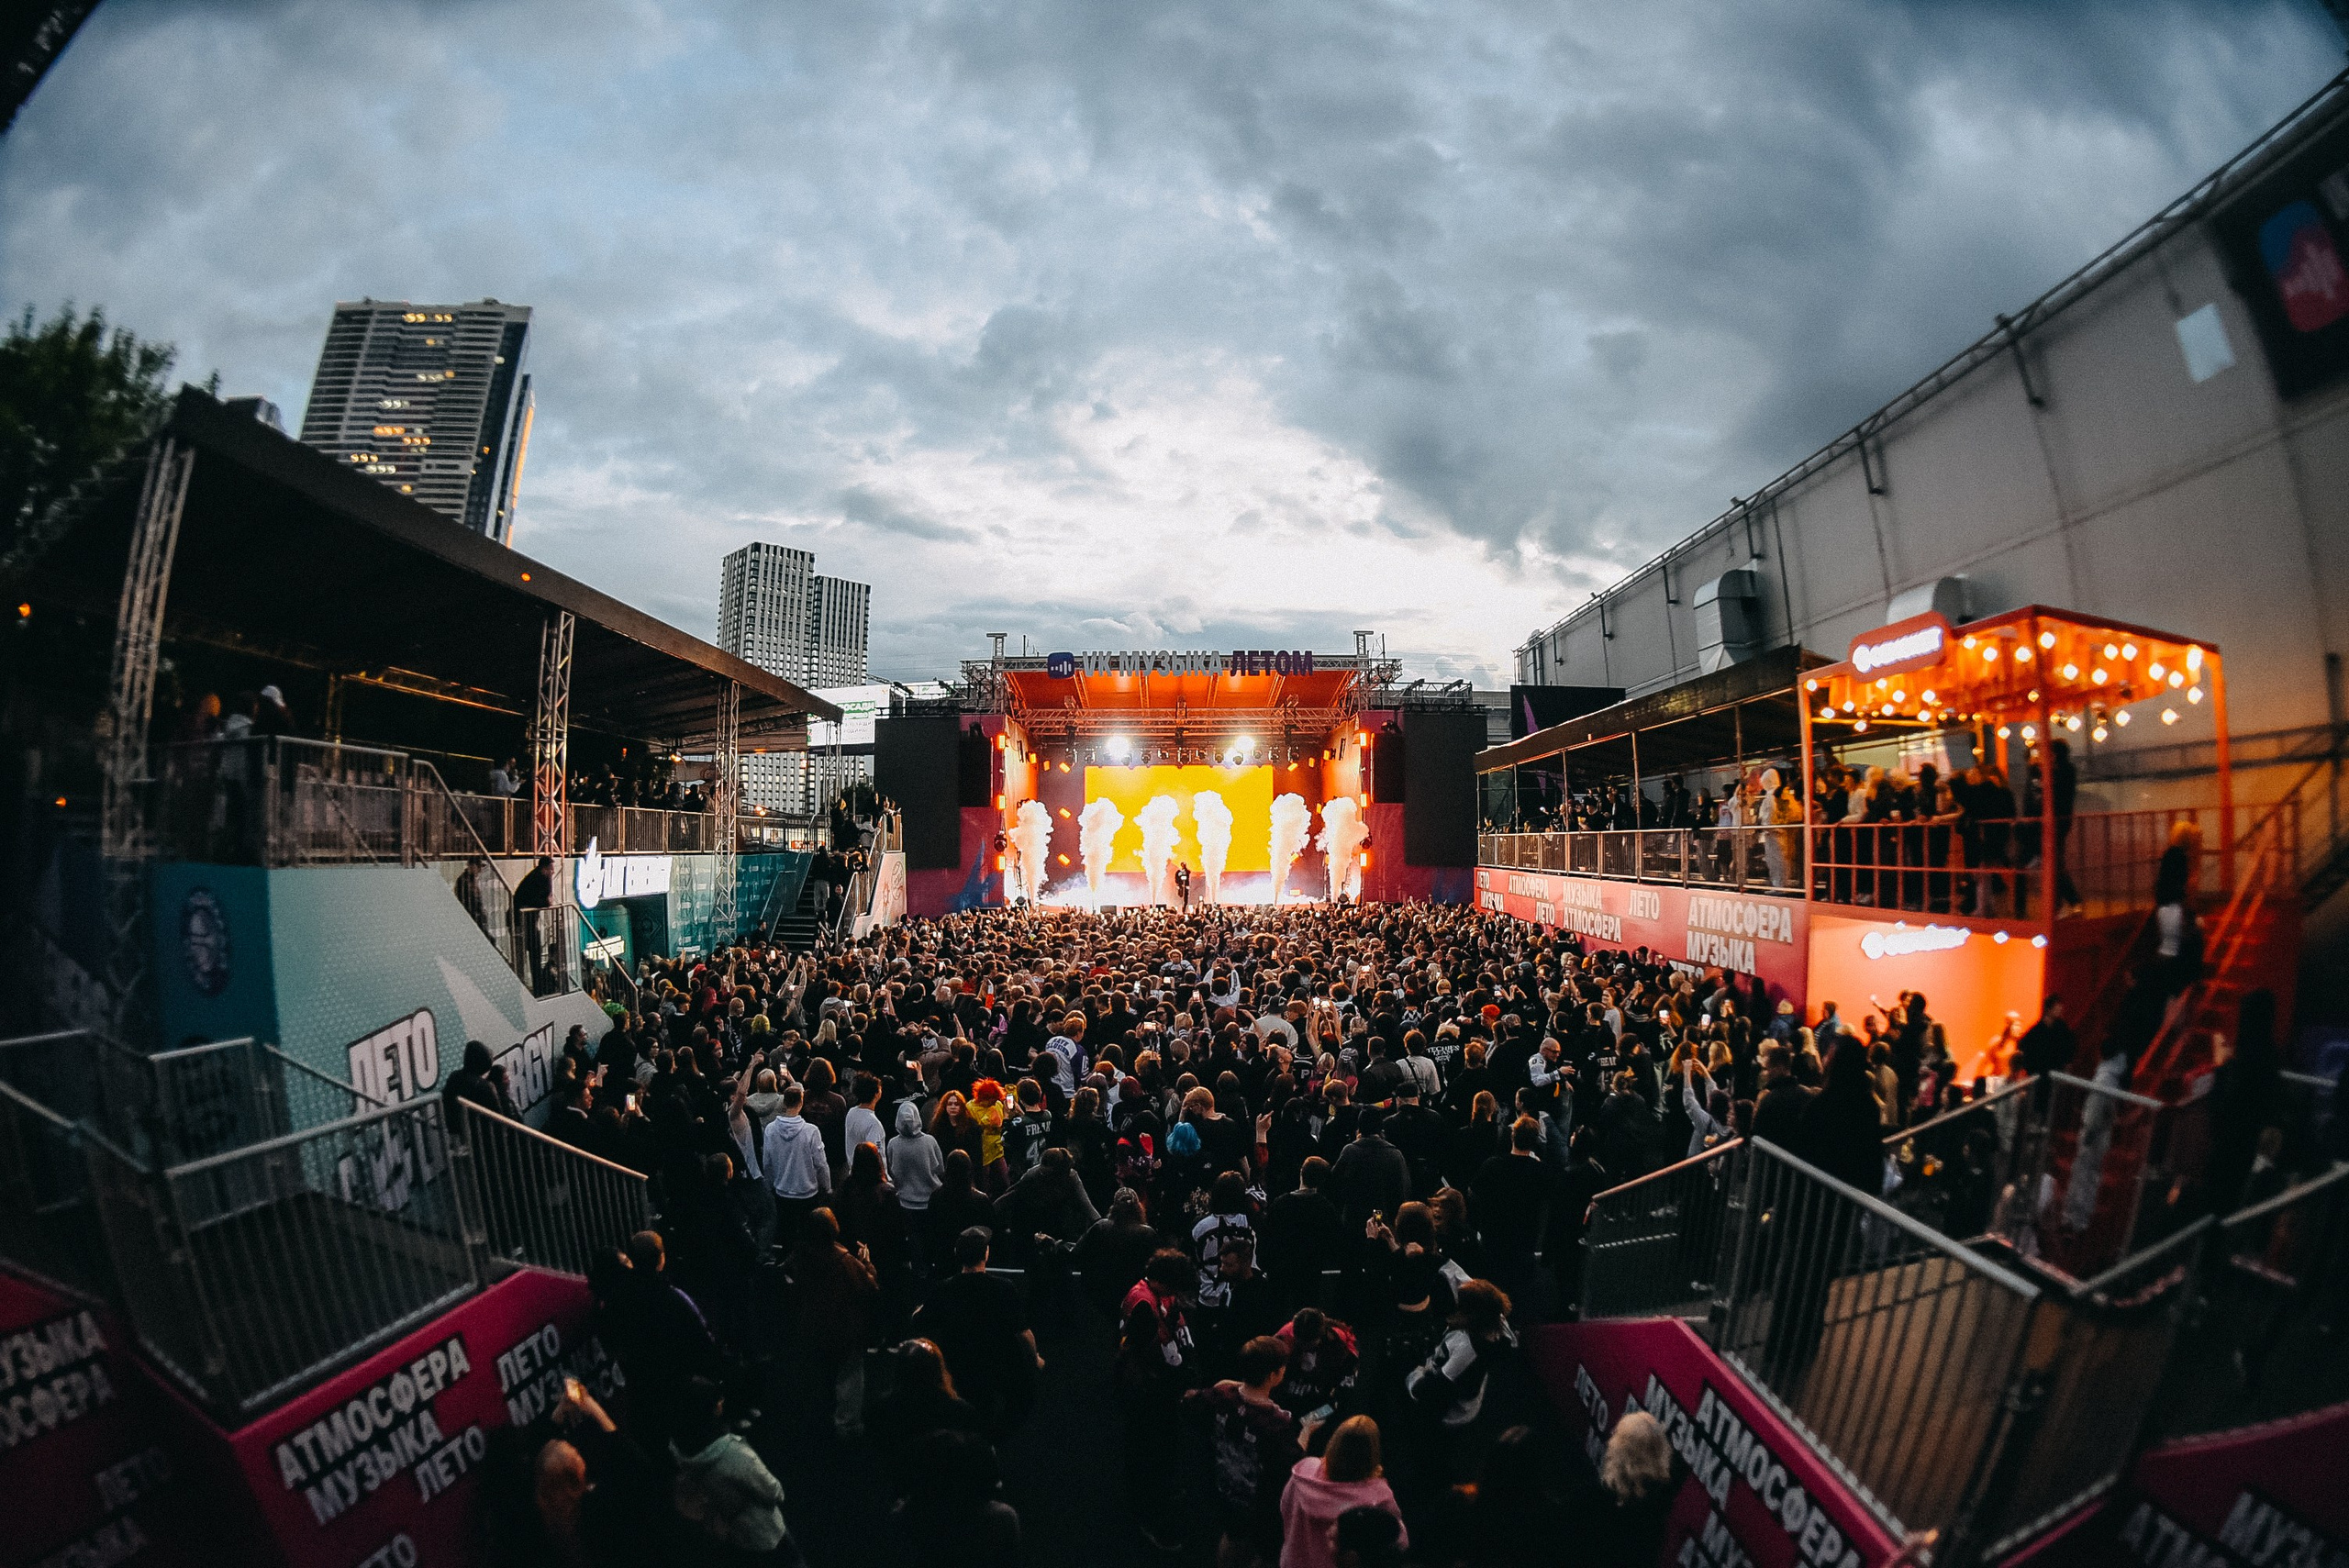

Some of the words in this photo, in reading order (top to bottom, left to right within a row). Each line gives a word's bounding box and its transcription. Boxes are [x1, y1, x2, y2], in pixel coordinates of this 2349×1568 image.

[1082, 651, 1112, 677] VK
[1119, 650, 1223, 677] МУЗЫКА
[1230, 650, 1313, 677] ЛЕТОМ
[1508, 874, 1549, 900] АТМОСФЕРА
[1563, 881, 1602, 909] МУЗЫКА
[1629, 889, 1660, 919] ЛЕТО
[1535, 901, 1555, 926] ЛЕТО
[1563, 906, 1622, 943] АТМОСФЕРА
[1687, 896, 1793, 943] АТМОСФЕРА
[1687, 930, 1756, 975] МУЗЫКА
[349, 1010, 439, 1116] ЛЕТО
[496, 1323, 561, 1395] ЛЕТО
[276, 1338, 471, 1490] АТМОСФЕРА
[1574, 1363, 1609, 1431] ЛЕТО
[415, 1425, 485, 1504] ЛЕТО
[1643, 1373, 1731, 1511] МУЗЫКА
[305, 1409, 444, 1526] МУЗЫКА
